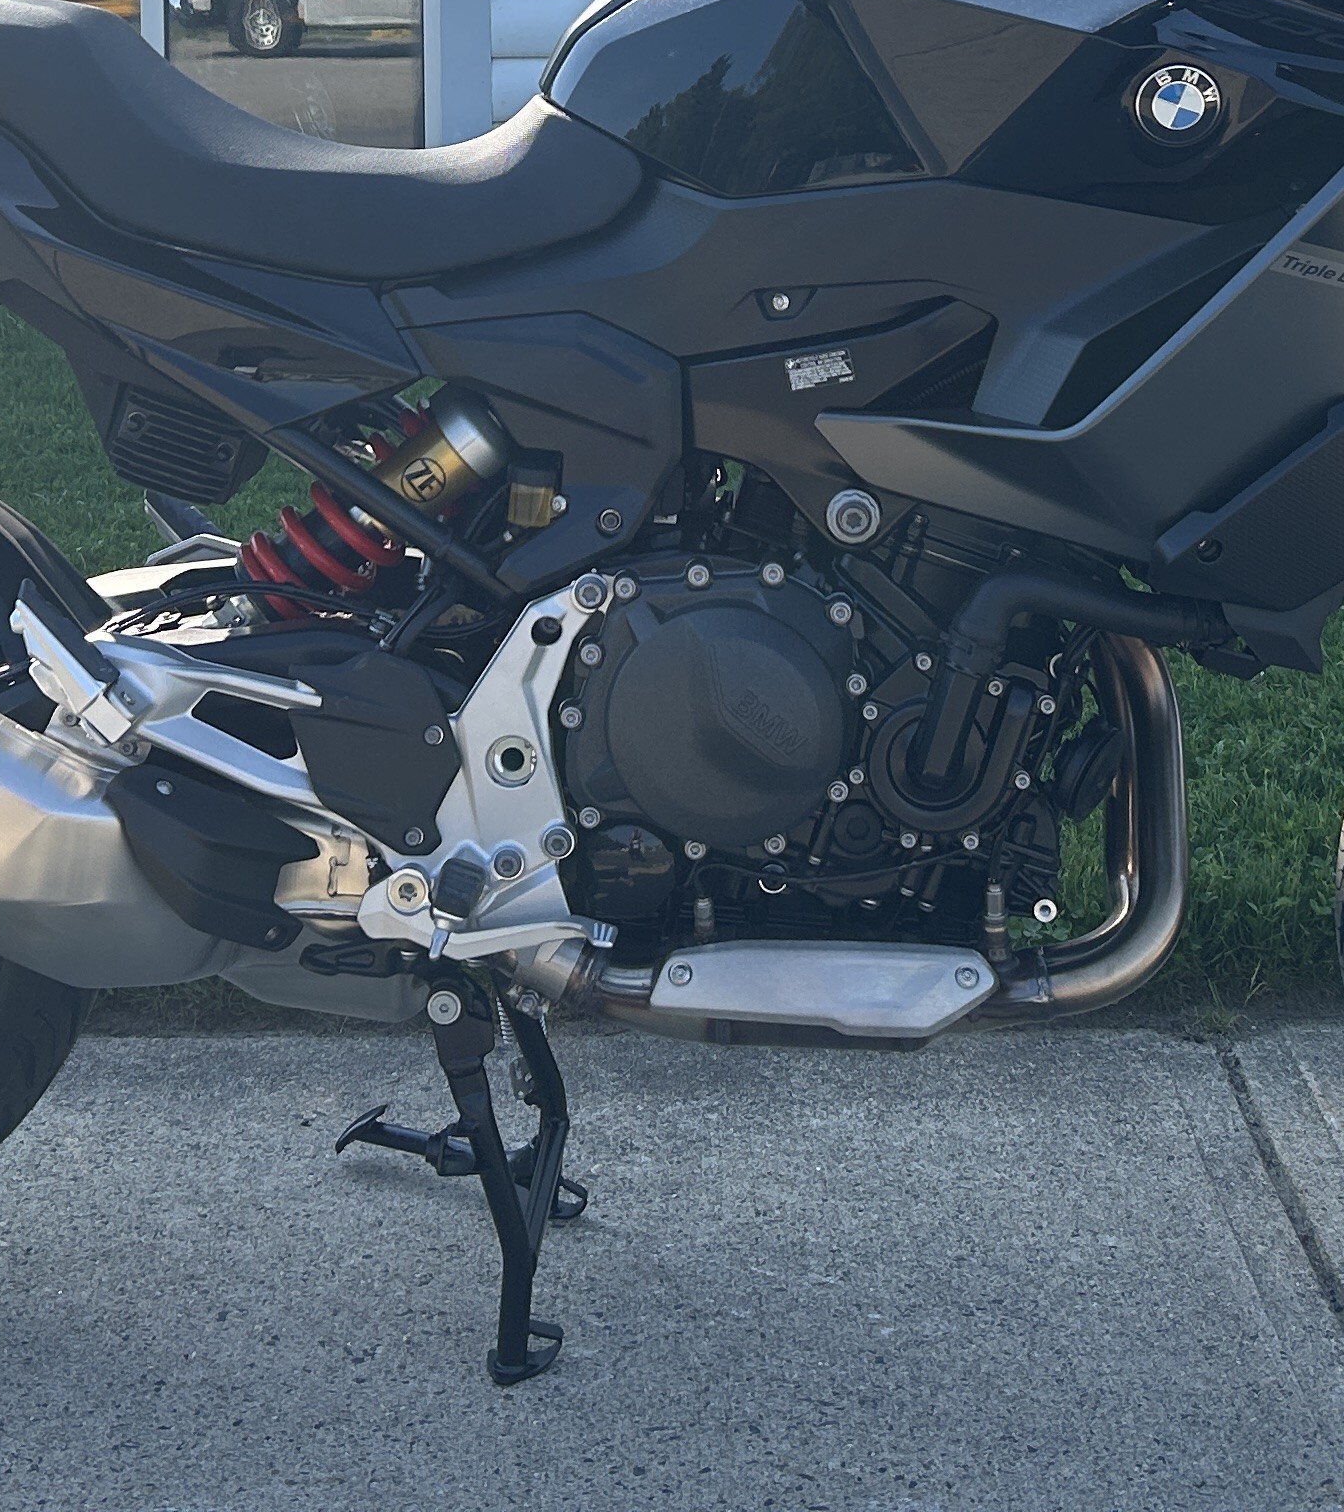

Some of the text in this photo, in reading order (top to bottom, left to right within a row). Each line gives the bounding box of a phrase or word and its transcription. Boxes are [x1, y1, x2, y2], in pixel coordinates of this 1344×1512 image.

[1154, 68, 1218, 103] BMW
[1282, 255, 1337, 280] Triple
[404, 458, 444, 502] ZF
[732, 688, 810, 756] BMW
